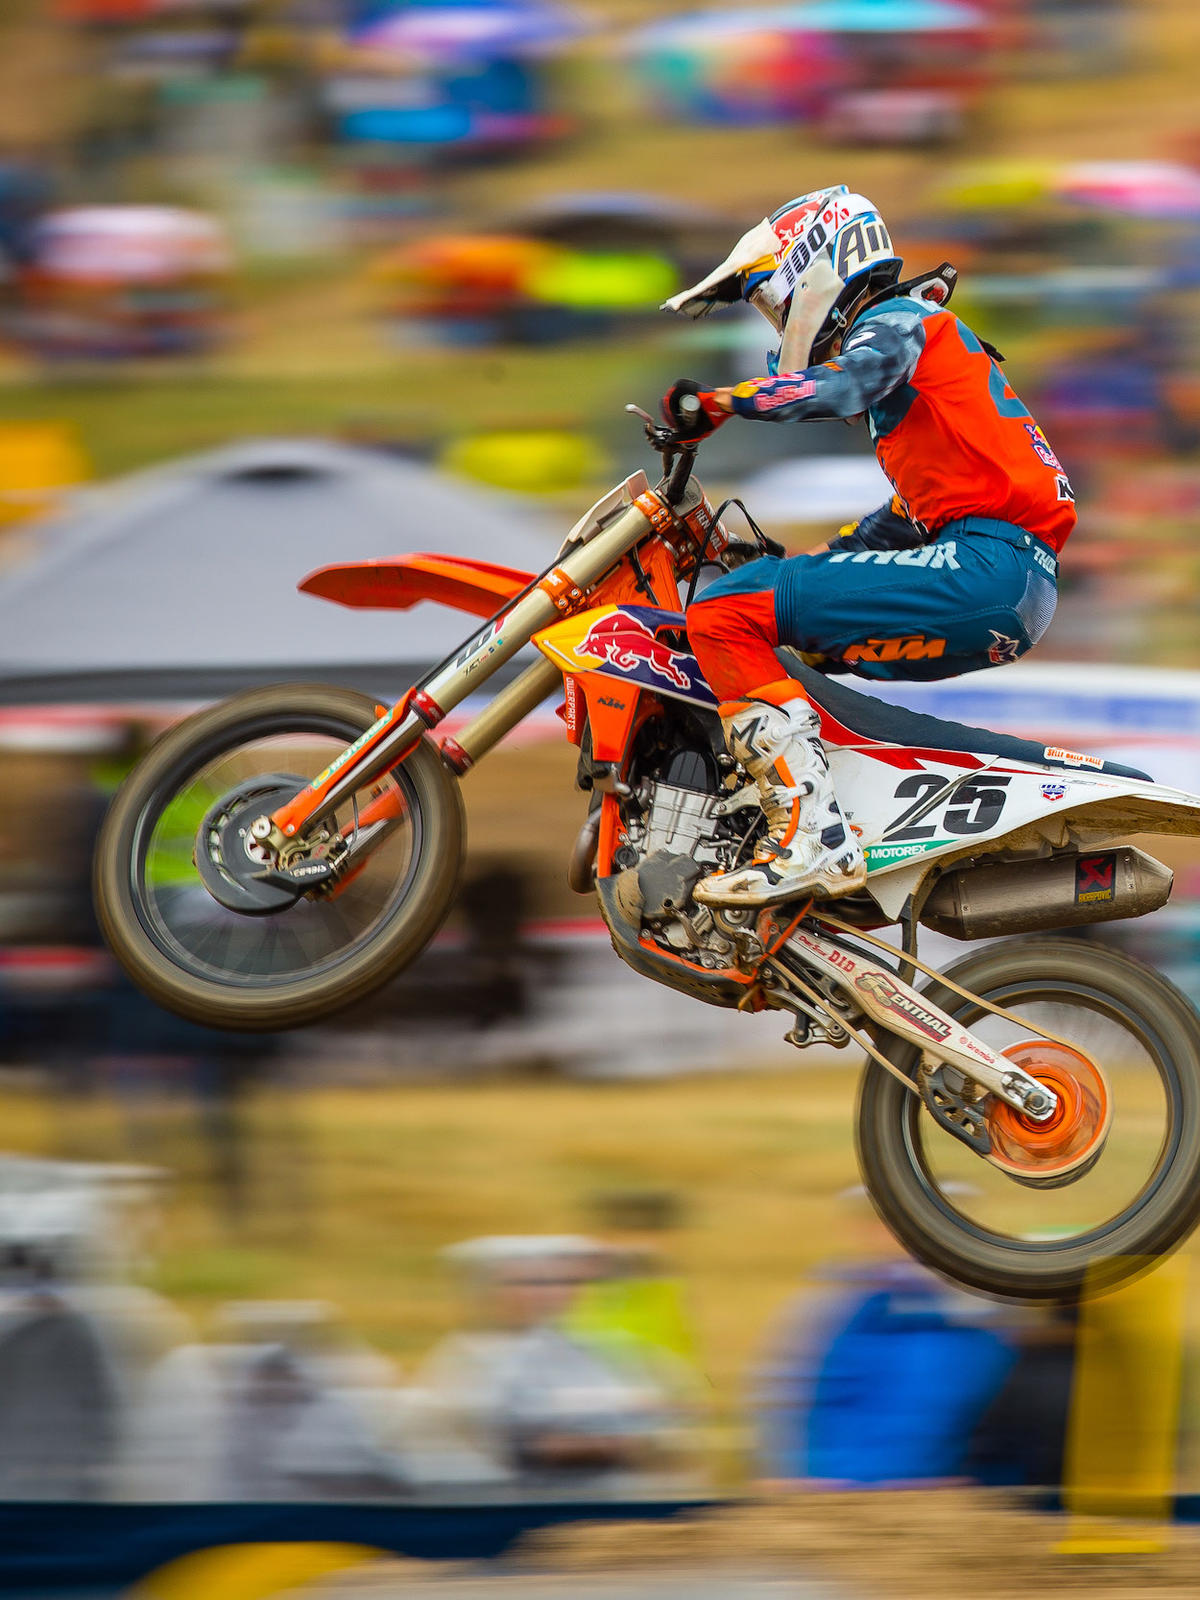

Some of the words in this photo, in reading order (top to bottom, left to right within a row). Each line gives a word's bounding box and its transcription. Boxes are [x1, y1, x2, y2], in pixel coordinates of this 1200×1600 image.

[780, 201, 849, 288] 100%
[695, 507, 723, 553] RENAL
[828, 540, 961, 570] THOR
[1033, 545, 1057, 577] THO
[842, 635, 947, 662] KTM
[882, 773, 1012, 843] 25
[871, 845, 927, 859] MOTOREX
[967, 1042, 995, 1064] brembo
